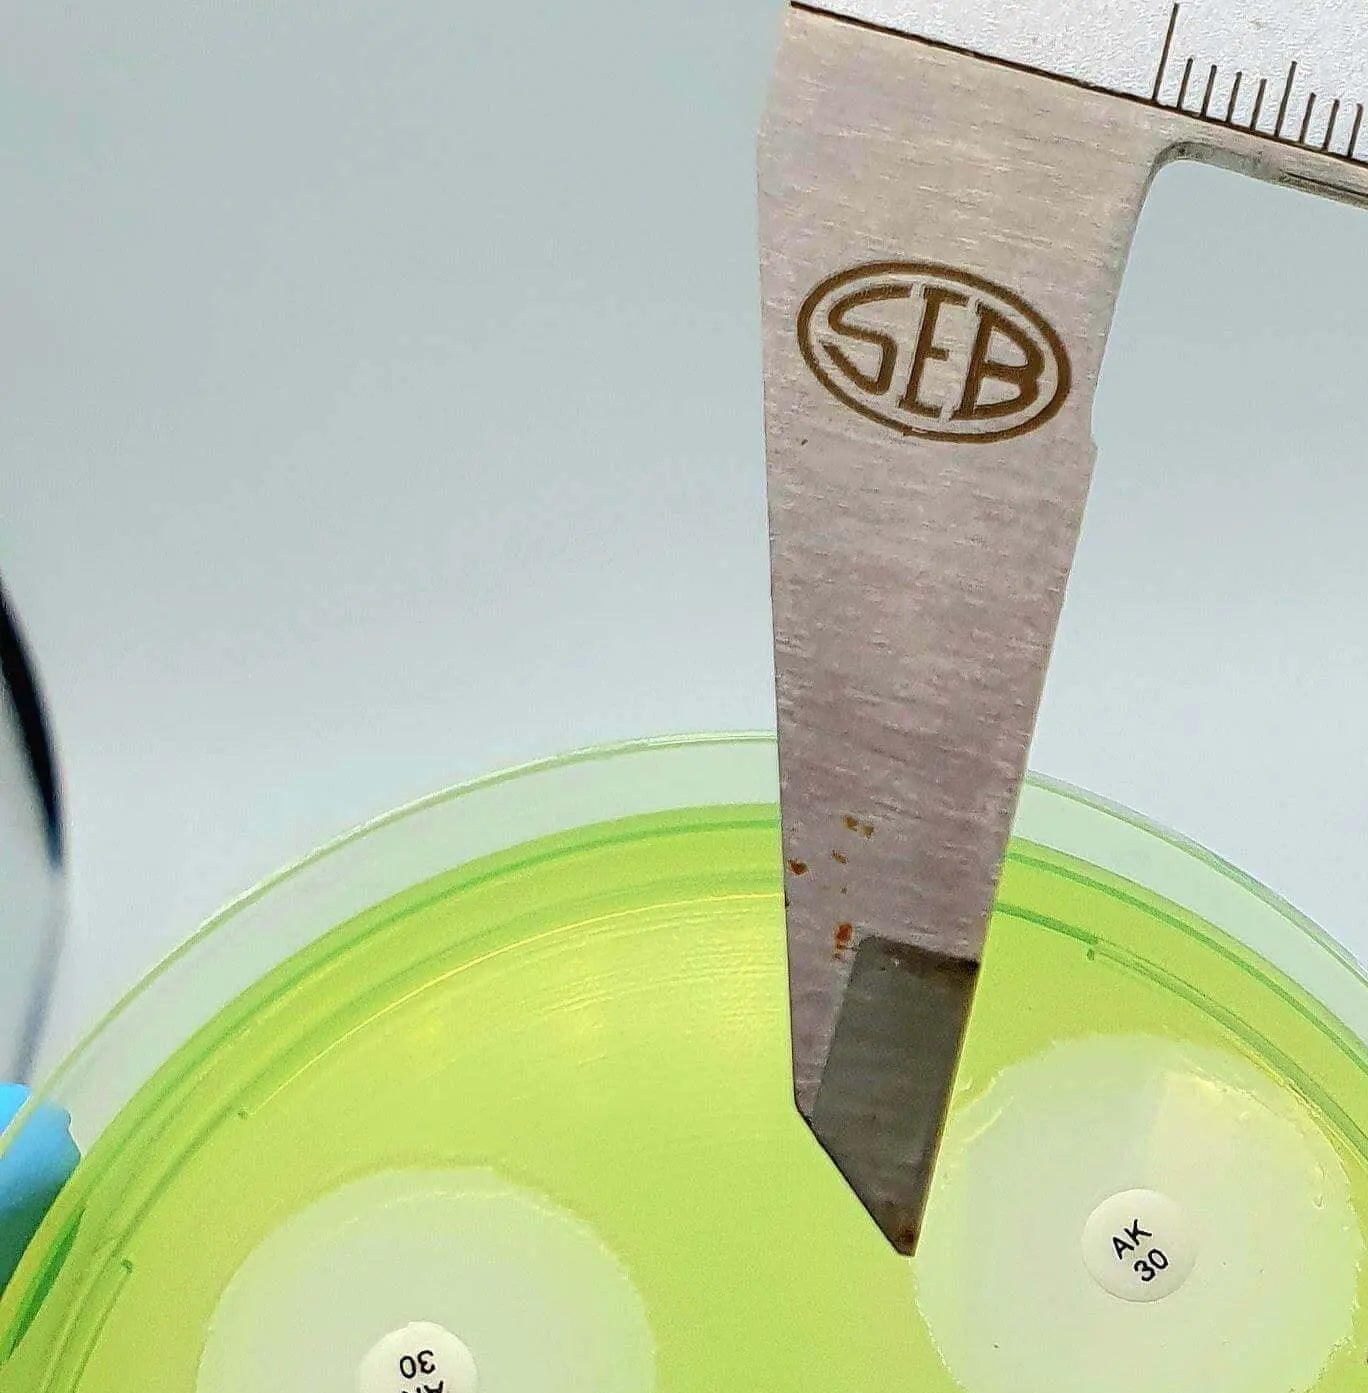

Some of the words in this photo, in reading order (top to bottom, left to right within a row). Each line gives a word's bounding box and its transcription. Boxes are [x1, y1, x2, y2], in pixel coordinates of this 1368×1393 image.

[826, 282, 1046, 421] SEB
[1111, 1218, 1153, 1261] AK
[1132, 1247, 1169, 1282] 30
[399, 1349, 436, 1380] 30
